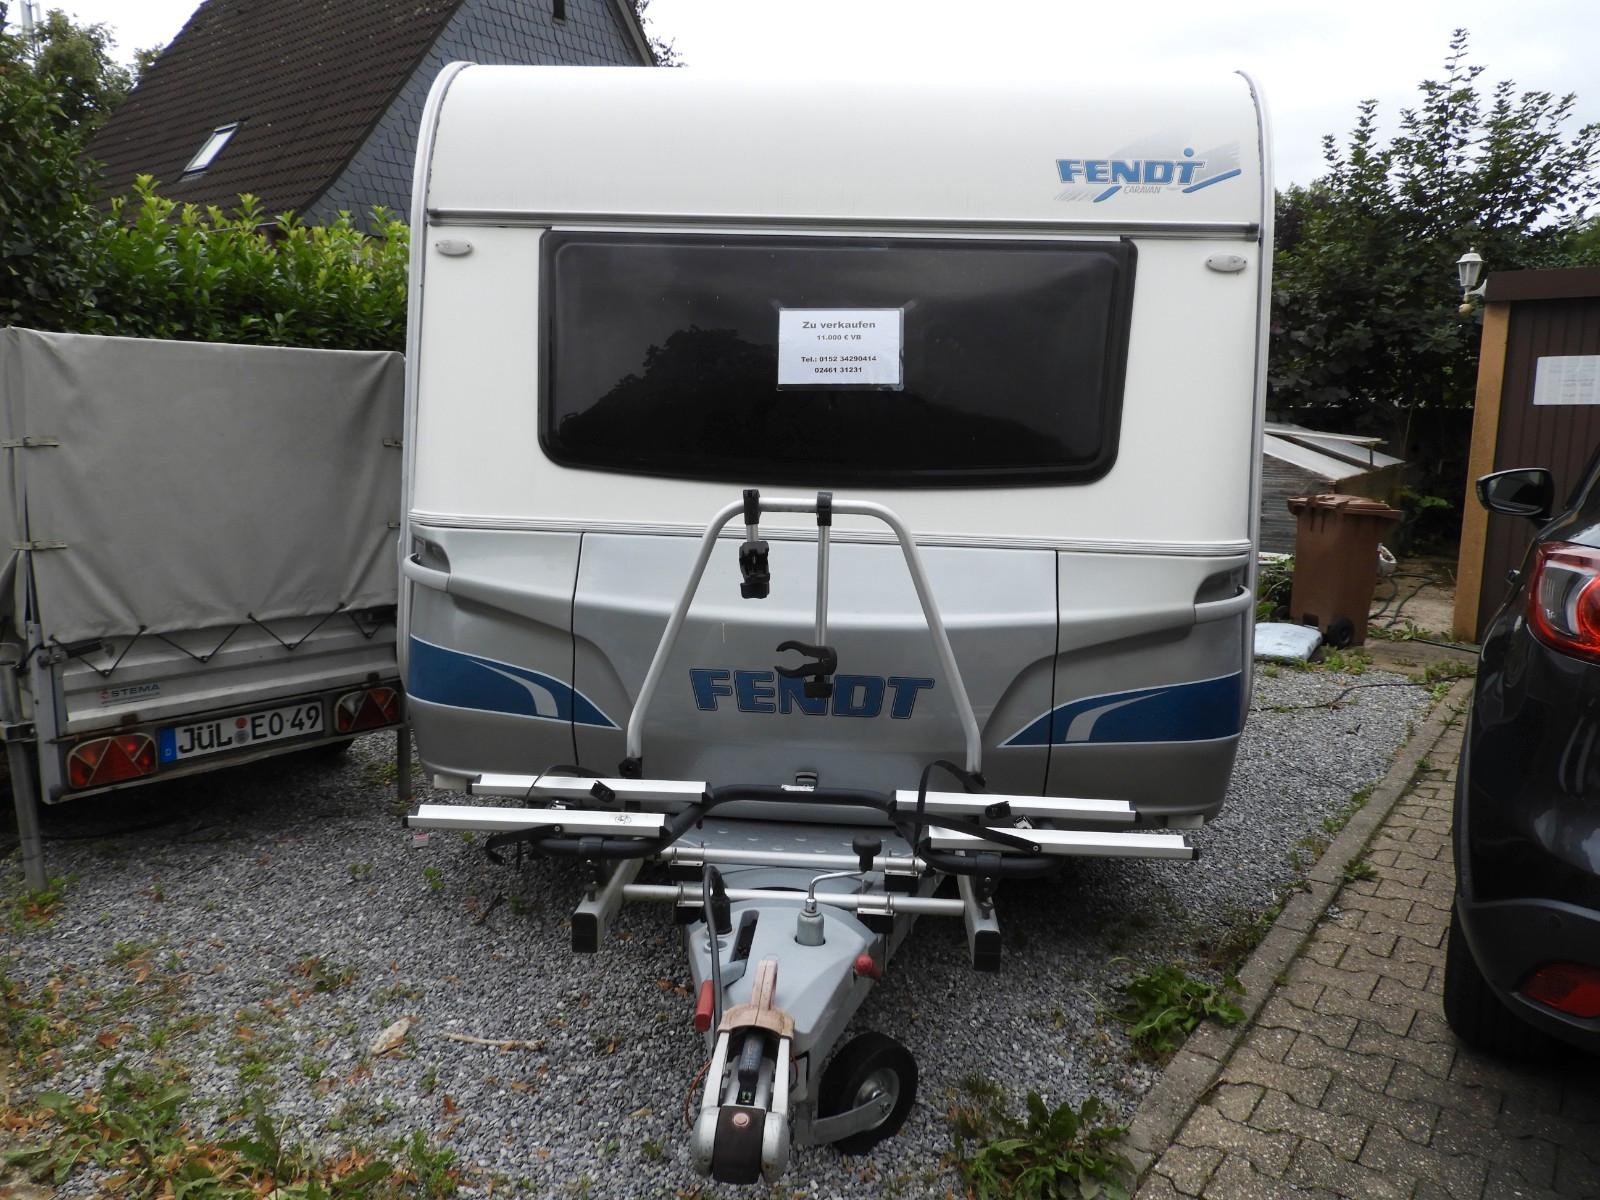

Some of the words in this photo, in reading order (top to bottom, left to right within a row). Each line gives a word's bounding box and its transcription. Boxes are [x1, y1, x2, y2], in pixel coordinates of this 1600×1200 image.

[1056, 159, 1206, 186] FENDT
[1123, 185, 1161, 195] CARAVAN
[802, 321, 817, 329] Zu
[820, 320, 876, 329] verkaufen
[111, 683, 160, 698] STEMA
[689, 668, 935, 720] FENDT
